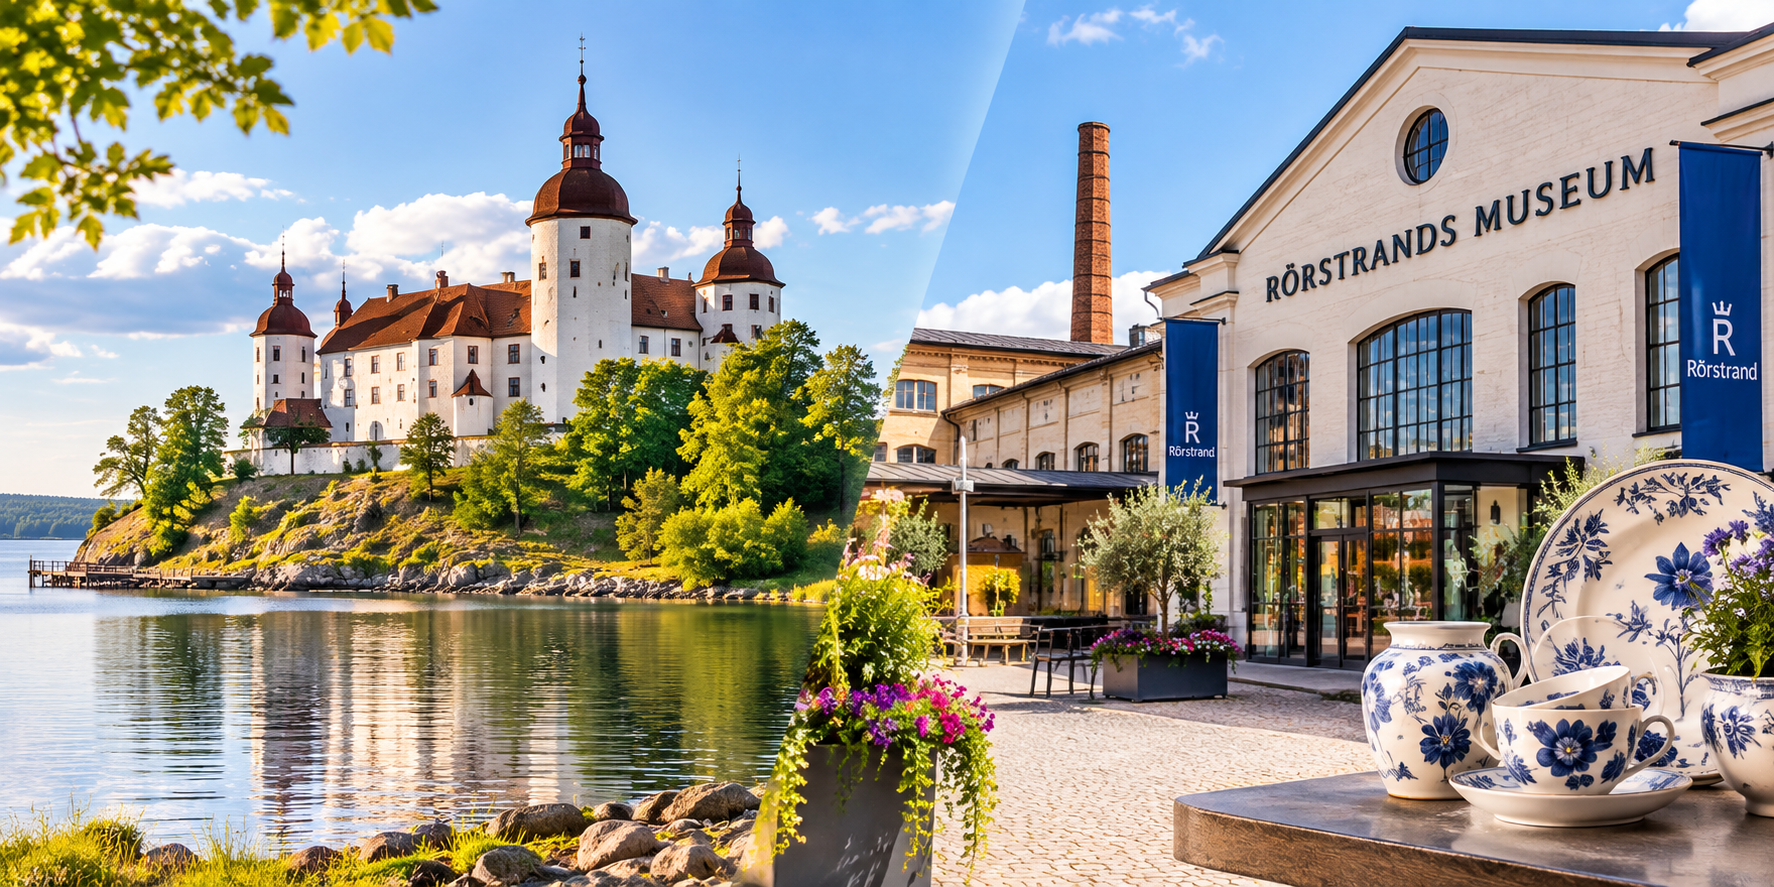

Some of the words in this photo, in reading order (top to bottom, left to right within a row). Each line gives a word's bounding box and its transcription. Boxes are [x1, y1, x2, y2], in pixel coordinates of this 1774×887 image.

[1266, 215, 1456, 302] RÖRSTRANDS
[1474, 147, 1656, 237] MUSEUM
[1713, 318, 1736, 356] R
[1185, 421, 1200, 444] R
